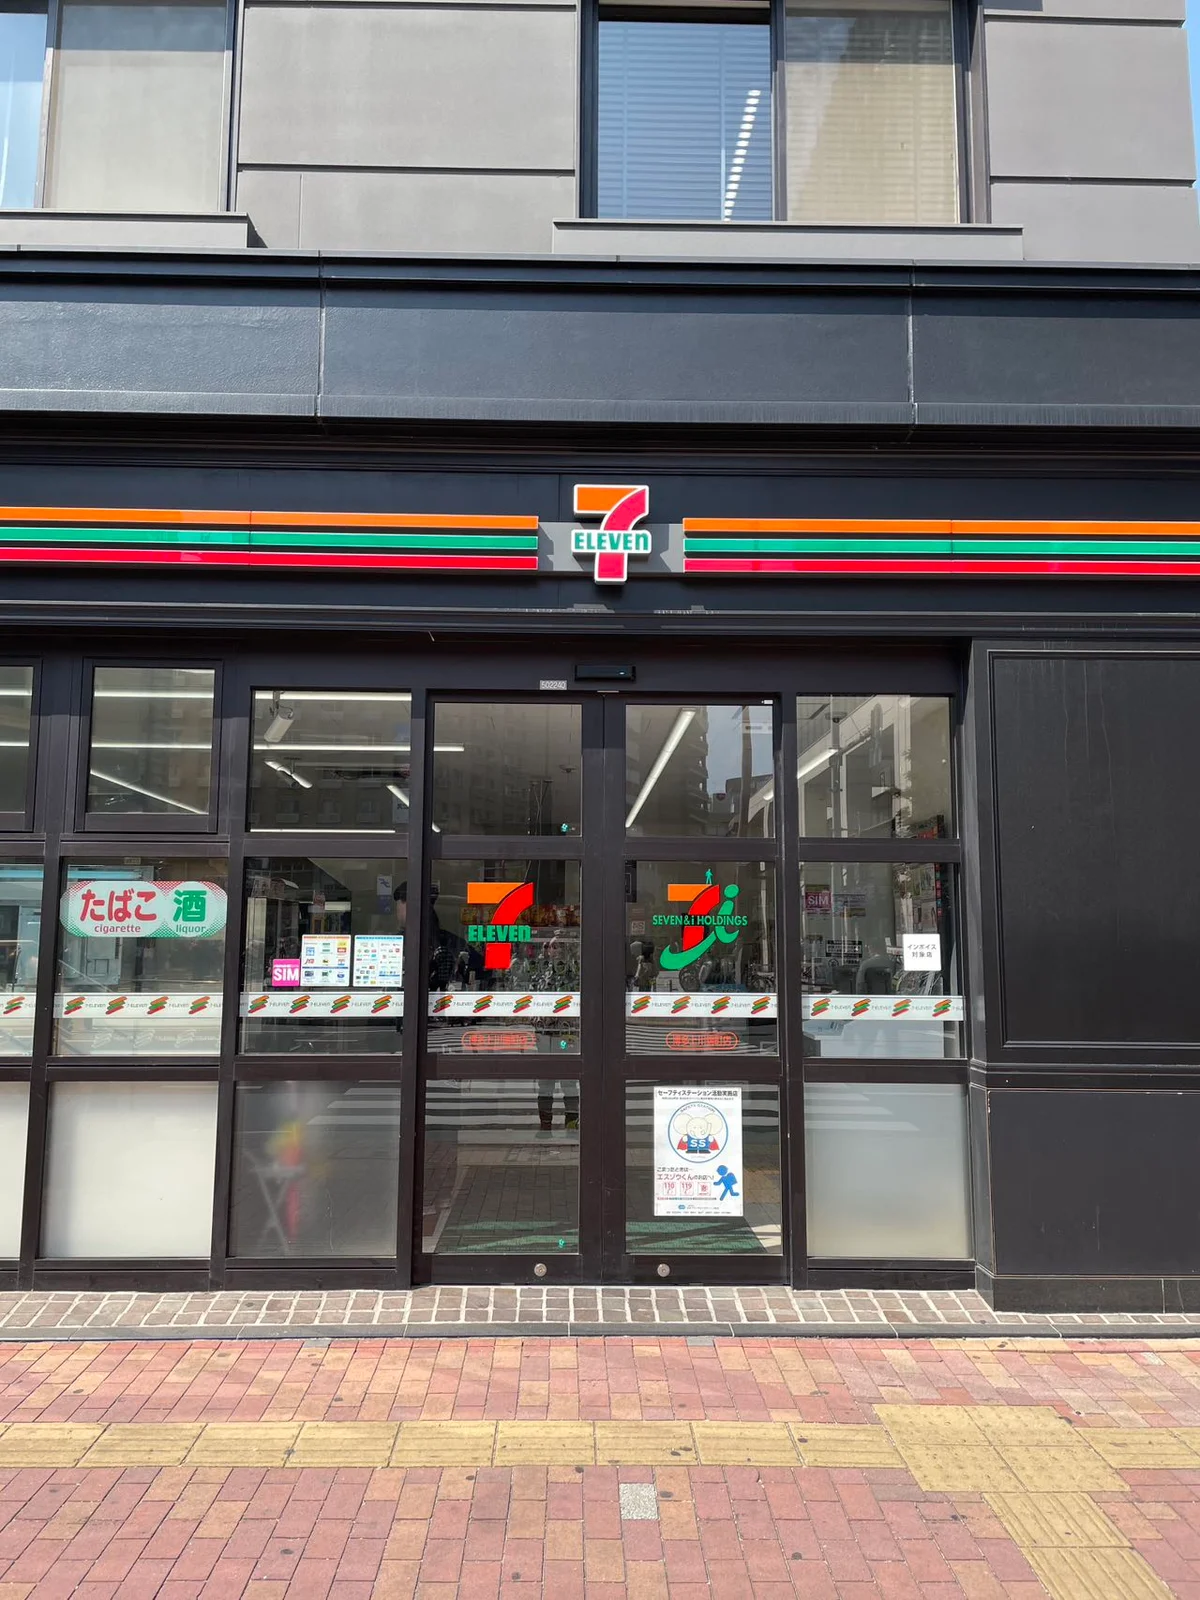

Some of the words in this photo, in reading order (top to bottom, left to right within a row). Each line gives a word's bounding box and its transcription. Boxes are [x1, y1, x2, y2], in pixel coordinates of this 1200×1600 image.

[80, 888, 157, 922] たばこ
[173, 889, 207, 922] 酒
[697, 915, 748, 926] HOLDINGS
[94, 924, 141, 934] cigarette
[175, 924, 207, 934] liquor
[273, 968, 299, 981] SIM
[690, 1139, 706, 1148] SS
